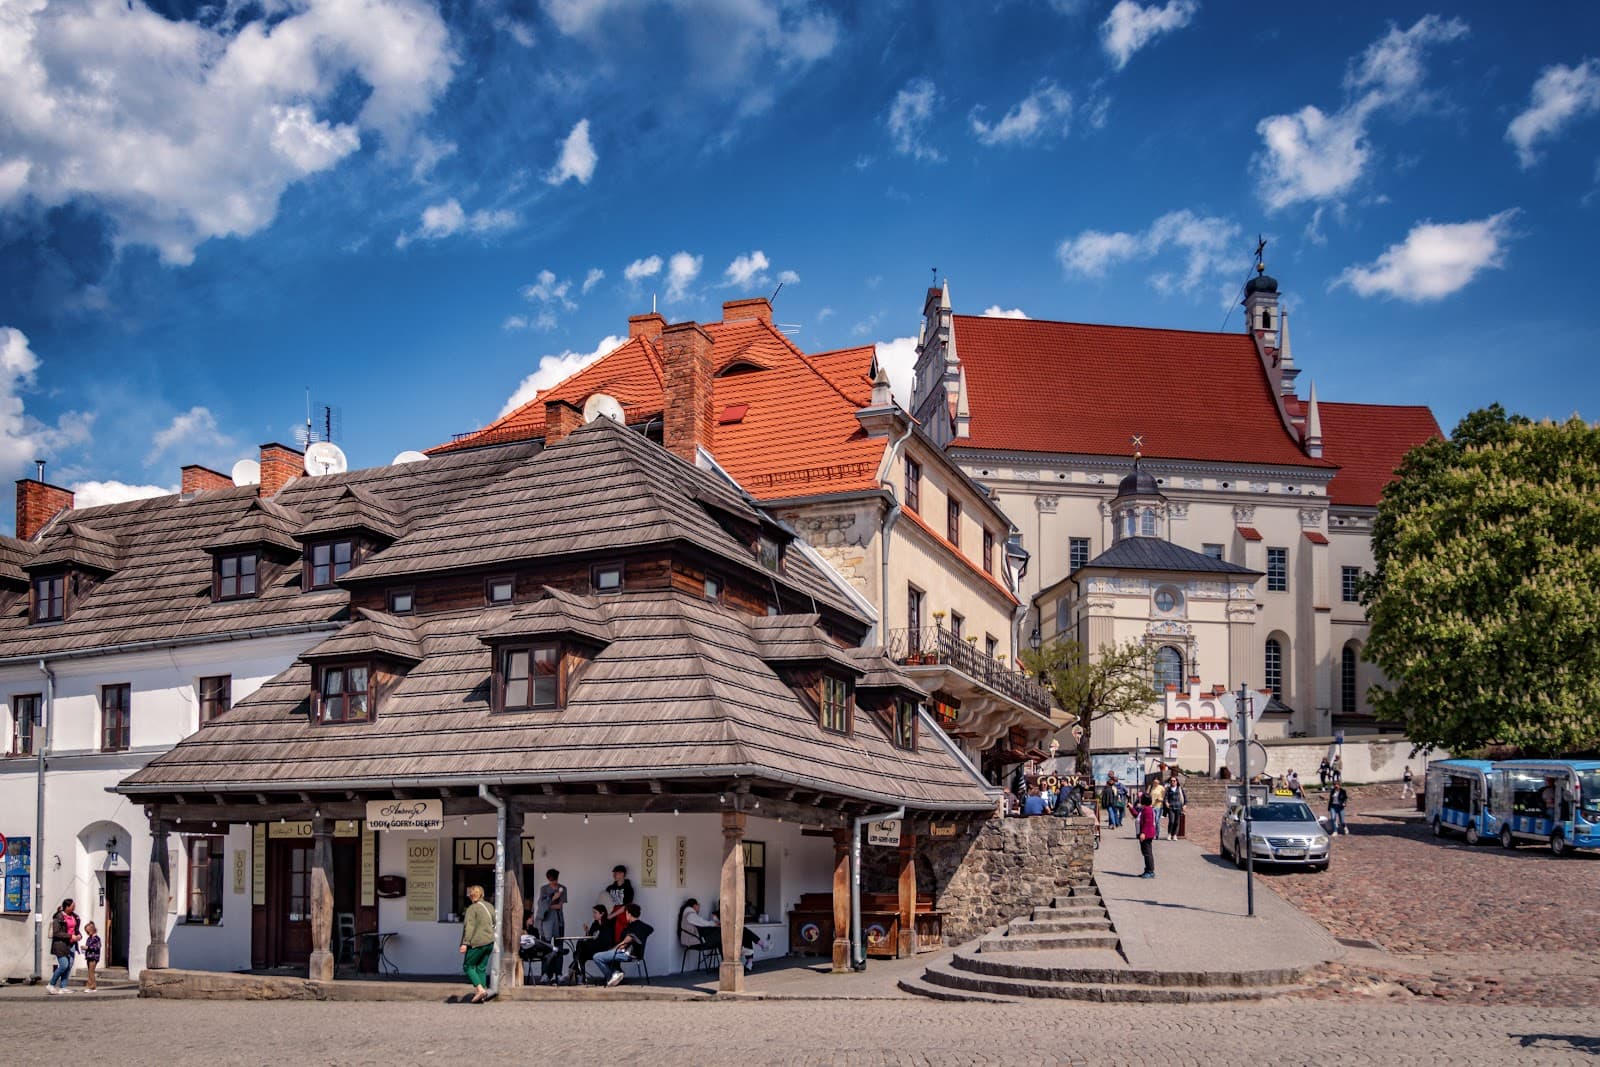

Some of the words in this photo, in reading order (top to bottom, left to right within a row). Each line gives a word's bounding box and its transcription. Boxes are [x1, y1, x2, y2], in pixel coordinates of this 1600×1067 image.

[1174, 722, 1220, 731] PASCHA
[297, 823, 313, 836] LO
[369, 820, 387, 828] LODY
[415, 819, 439, 827] DESERY
[409, 847, 435, 858] LODY
[645, 838, 654, 878] LODY
[236, 853, 244, 885] LODY
